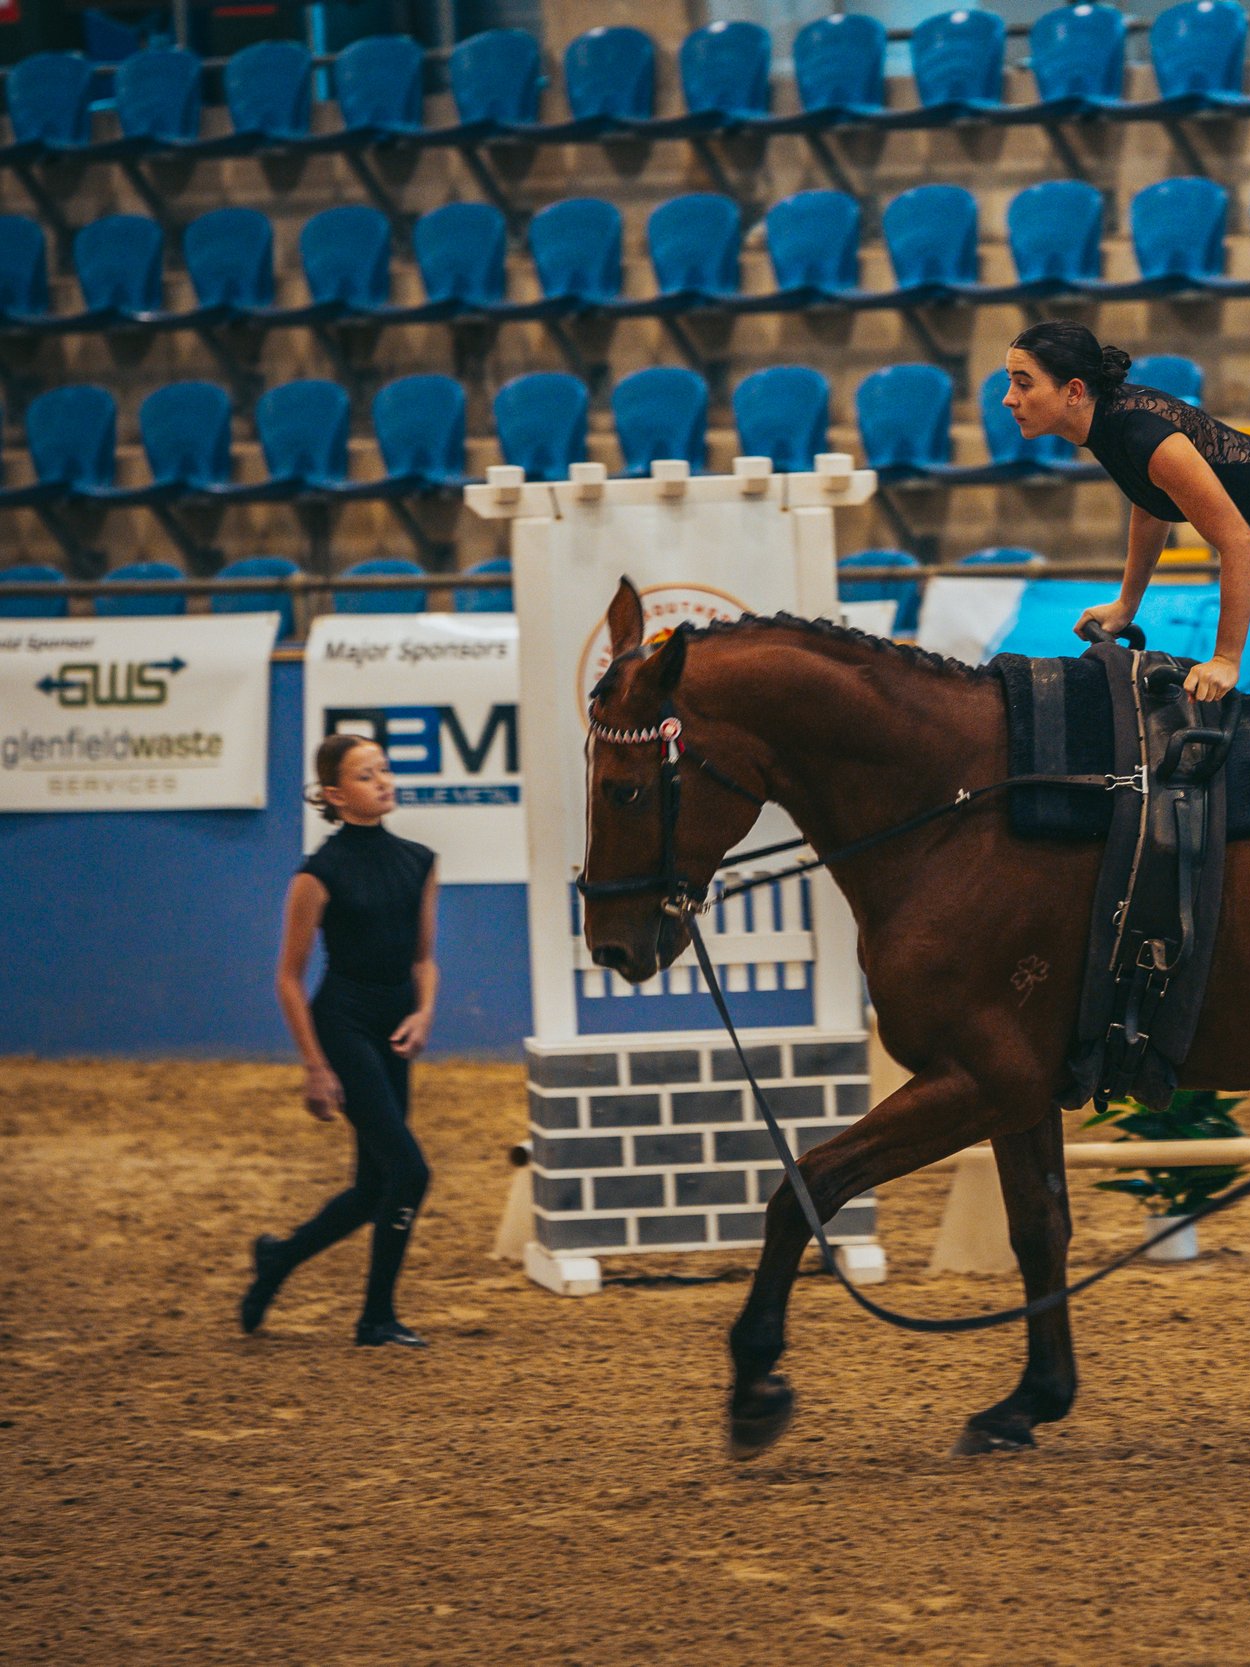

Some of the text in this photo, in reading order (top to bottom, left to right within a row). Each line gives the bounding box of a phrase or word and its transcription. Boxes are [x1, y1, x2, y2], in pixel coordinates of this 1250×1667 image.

[325, 640, 508, 668] Major Sponsors
[2, 728, 223, 769] glenfieldwaste
[48, 774, 178, 794] SERVICES
